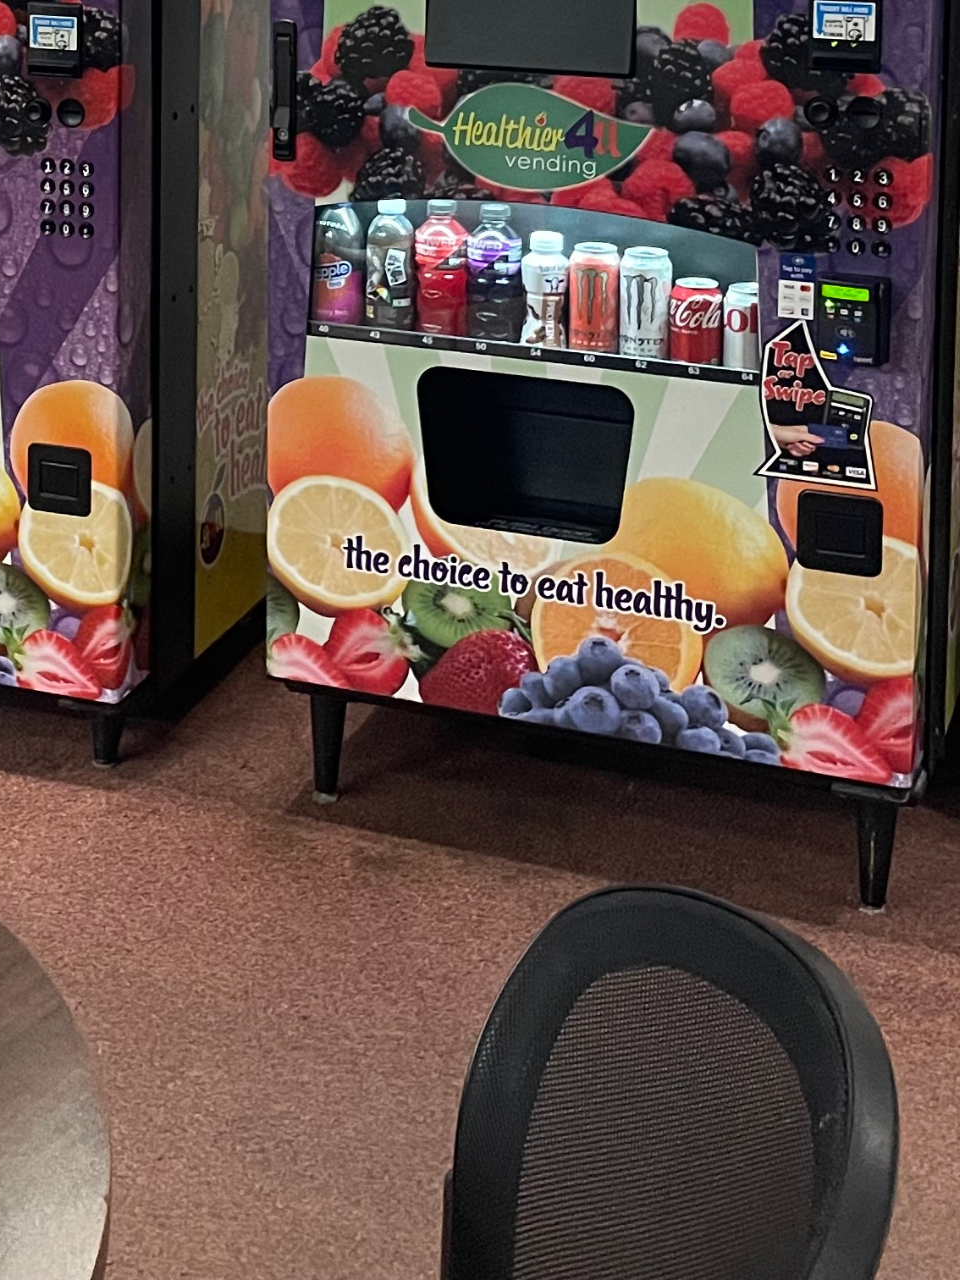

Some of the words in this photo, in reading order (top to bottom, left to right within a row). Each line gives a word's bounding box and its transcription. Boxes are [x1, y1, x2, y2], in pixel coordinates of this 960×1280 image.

[44, 161, 51, 172] 1
[64, 162, 70, 172] 2
[83, 164, 90, 175] 3
[504, 154, 597, 179] vending
[829, 169, 836, 180] 1
[854, 171, 862, 182] 2
[880, 173, 887, 184] 3
[44, 181, 51, 192] 4
[827, 193, 835, 204] 4
[853, 195, 861, 206] 5
[879, 197, 887, 208] 6
[827, 216, 835, 227] 7
[853, 219, 860, 230] 8
[878, 221, 886, 231] 9
[62, 224, 70, 235] 0
[852, 243, 860, 253] 0
[421, 335, 433, 345] 45
[475, 342, 487, 351] 50
[530, 347, 542, 357] 54
[583, 353, 596, 363] 60
[771, 340, 816, 378] Tap
[635, 359, 648, 369] 62
[687, 365, 700, 375] 63
[741, 371, 754, 381] 64
[763, 375, 827, 412] Swipe
[230, 436, 266, 498] heal
[847, 469, 865, 477] VISA
[343, 535, 390, 574] the
[397, 544, 491, 590] choice
[498, 561, 529, 594] to
[538, 572, 589, 605] eat
[595, 570, 726, 632] healthy.
